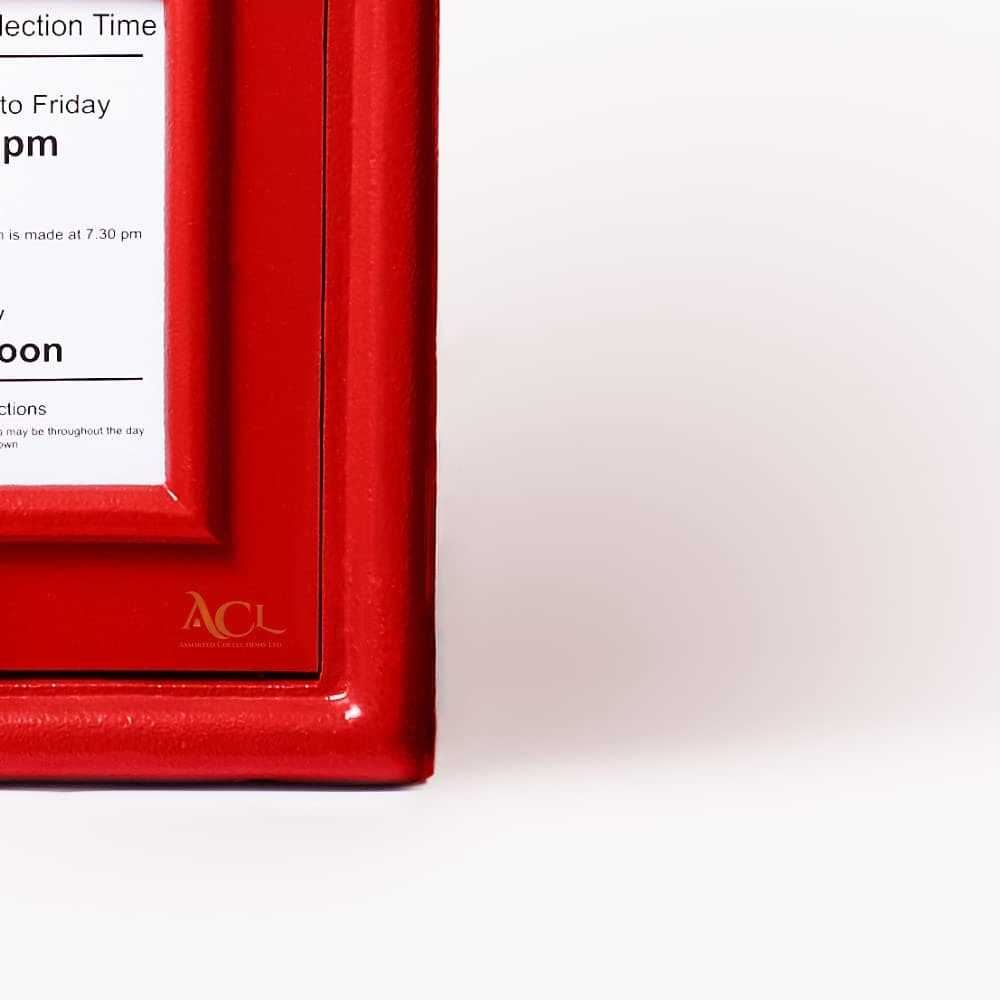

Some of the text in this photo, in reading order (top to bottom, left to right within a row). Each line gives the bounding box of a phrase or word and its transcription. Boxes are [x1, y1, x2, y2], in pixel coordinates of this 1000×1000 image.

[92, 12, 157, 37] Time
[0, 95, 23, 115] to
[32, 94, 111, 120] Friday
[3, 135, 58, 165] pm
[9, 228, 20, 241] is
[24, 229, 64, 241] made
[67, 229, 81, 241] at
[86, 228, 116, 240] 7.30
[120, 230, 142, 243] pm
[6, 428, 28, 438] may
[31, 427, 45, 436] be
[47, 426, 103, 438] throughout
[106, 426, 123, 435] the
[125, 425, 145, 437] day
